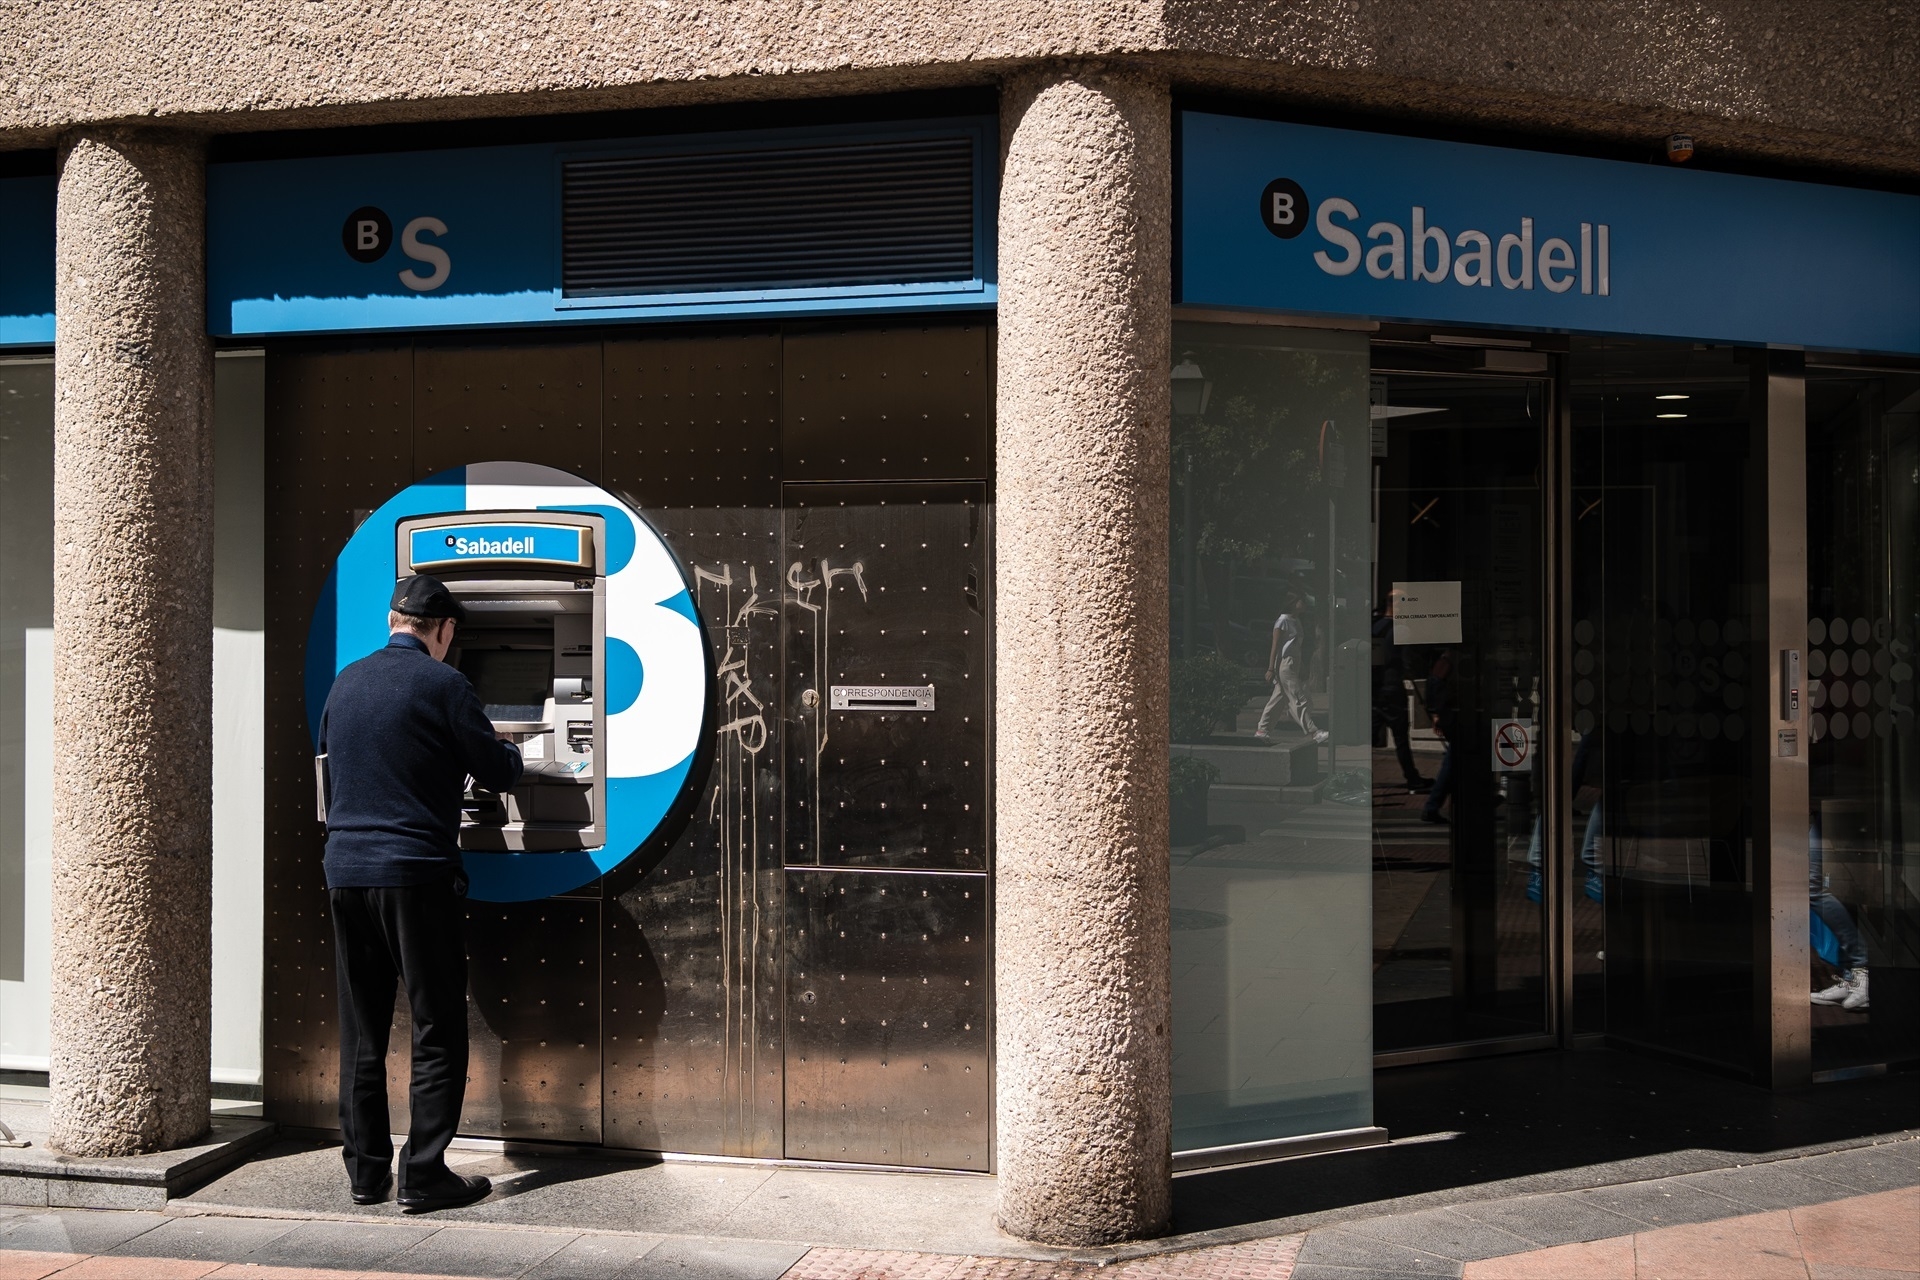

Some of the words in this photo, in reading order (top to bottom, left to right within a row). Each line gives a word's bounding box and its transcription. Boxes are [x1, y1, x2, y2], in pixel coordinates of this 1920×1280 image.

[357, 220, 380, 250] B
[398, 216, 451, 292] S
[1273, 192, 1295, 225] B
[1313, 197, 1610, 297] Sabadell
[455, 537, 535, 555] Sabadell
[833, 688, 932, 698] CORRESPONDENCIA
